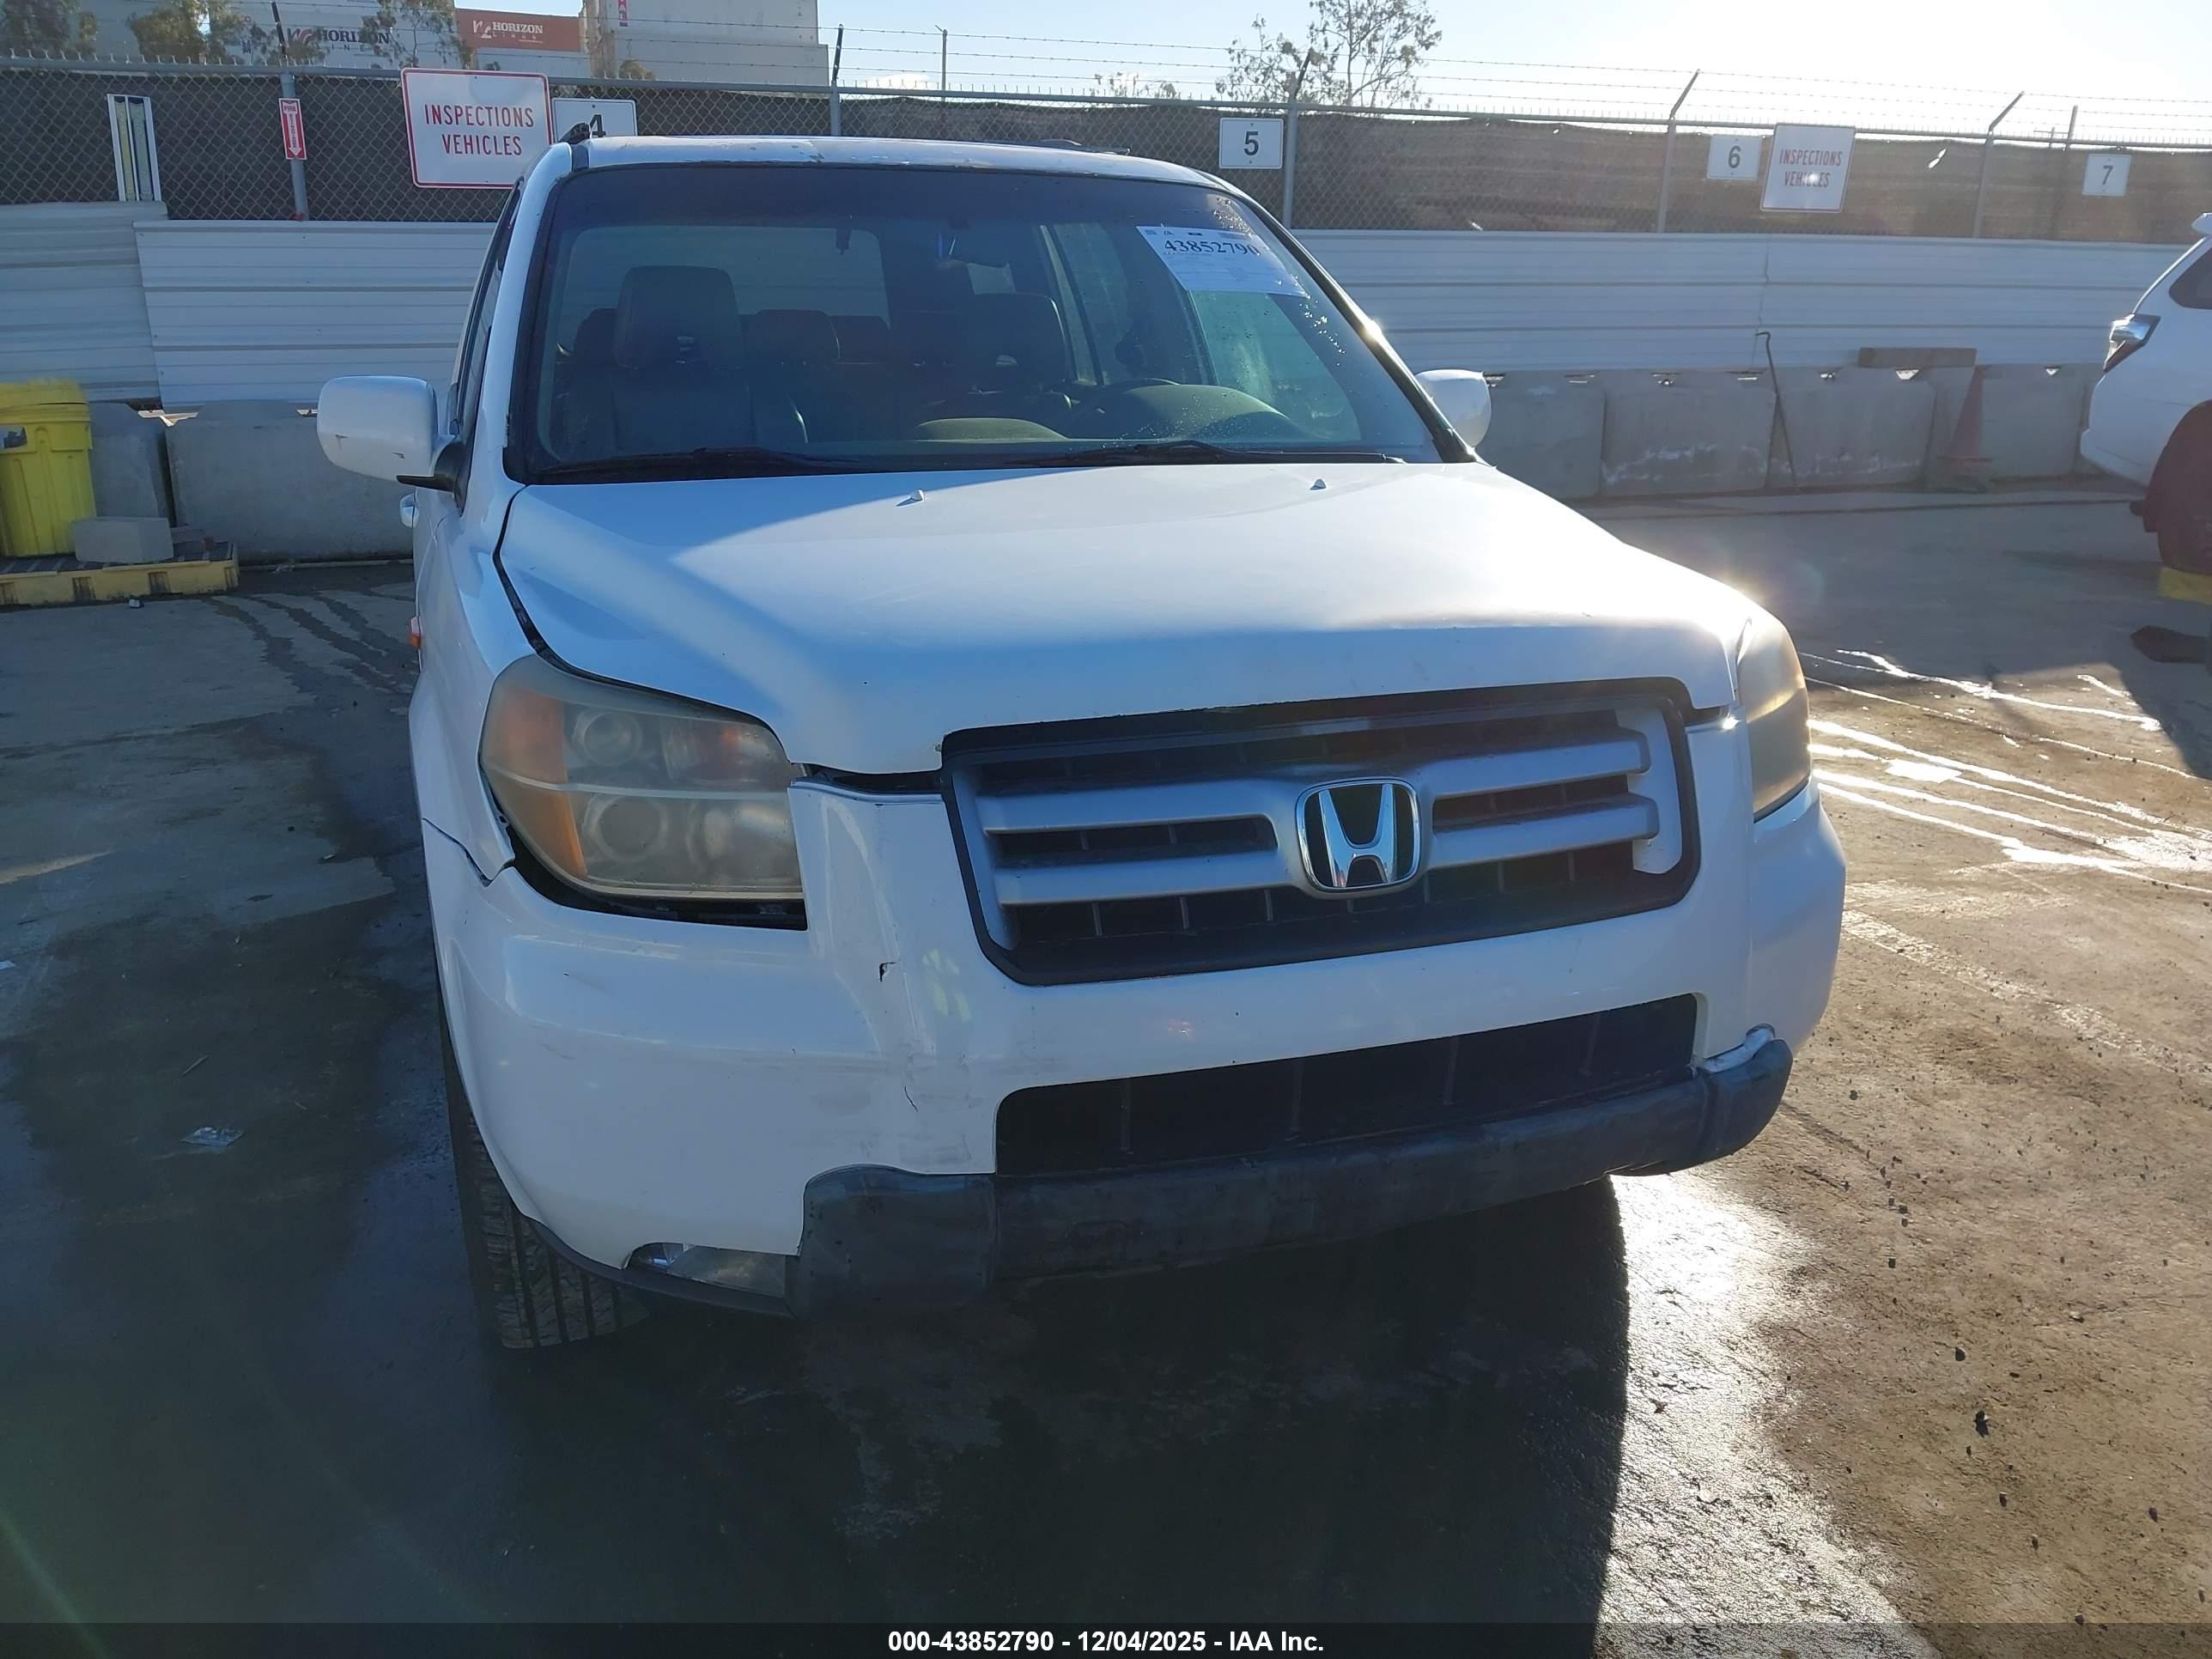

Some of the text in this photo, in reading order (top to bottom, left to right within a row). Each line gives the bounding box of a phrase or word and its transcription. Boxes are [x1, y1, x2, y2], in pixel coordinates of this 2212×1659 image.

[319, 28, 390, 43] HORION
[492, 21, 544, 33] HORIZON
[424, 104, 534, 128] INSPECTIONS
[589, 113, 606, 137] 4
[442, 134, 522, 155] VEHICLES
[1243, 131, 1259, 155] 5
[1728, 145, 1741, 169] 6
[1779, 149, 1843, 167] INSPECTIONS
[2102, 165, 2114, 185] 7
[1164, 240, 1261, 255] 43852790
